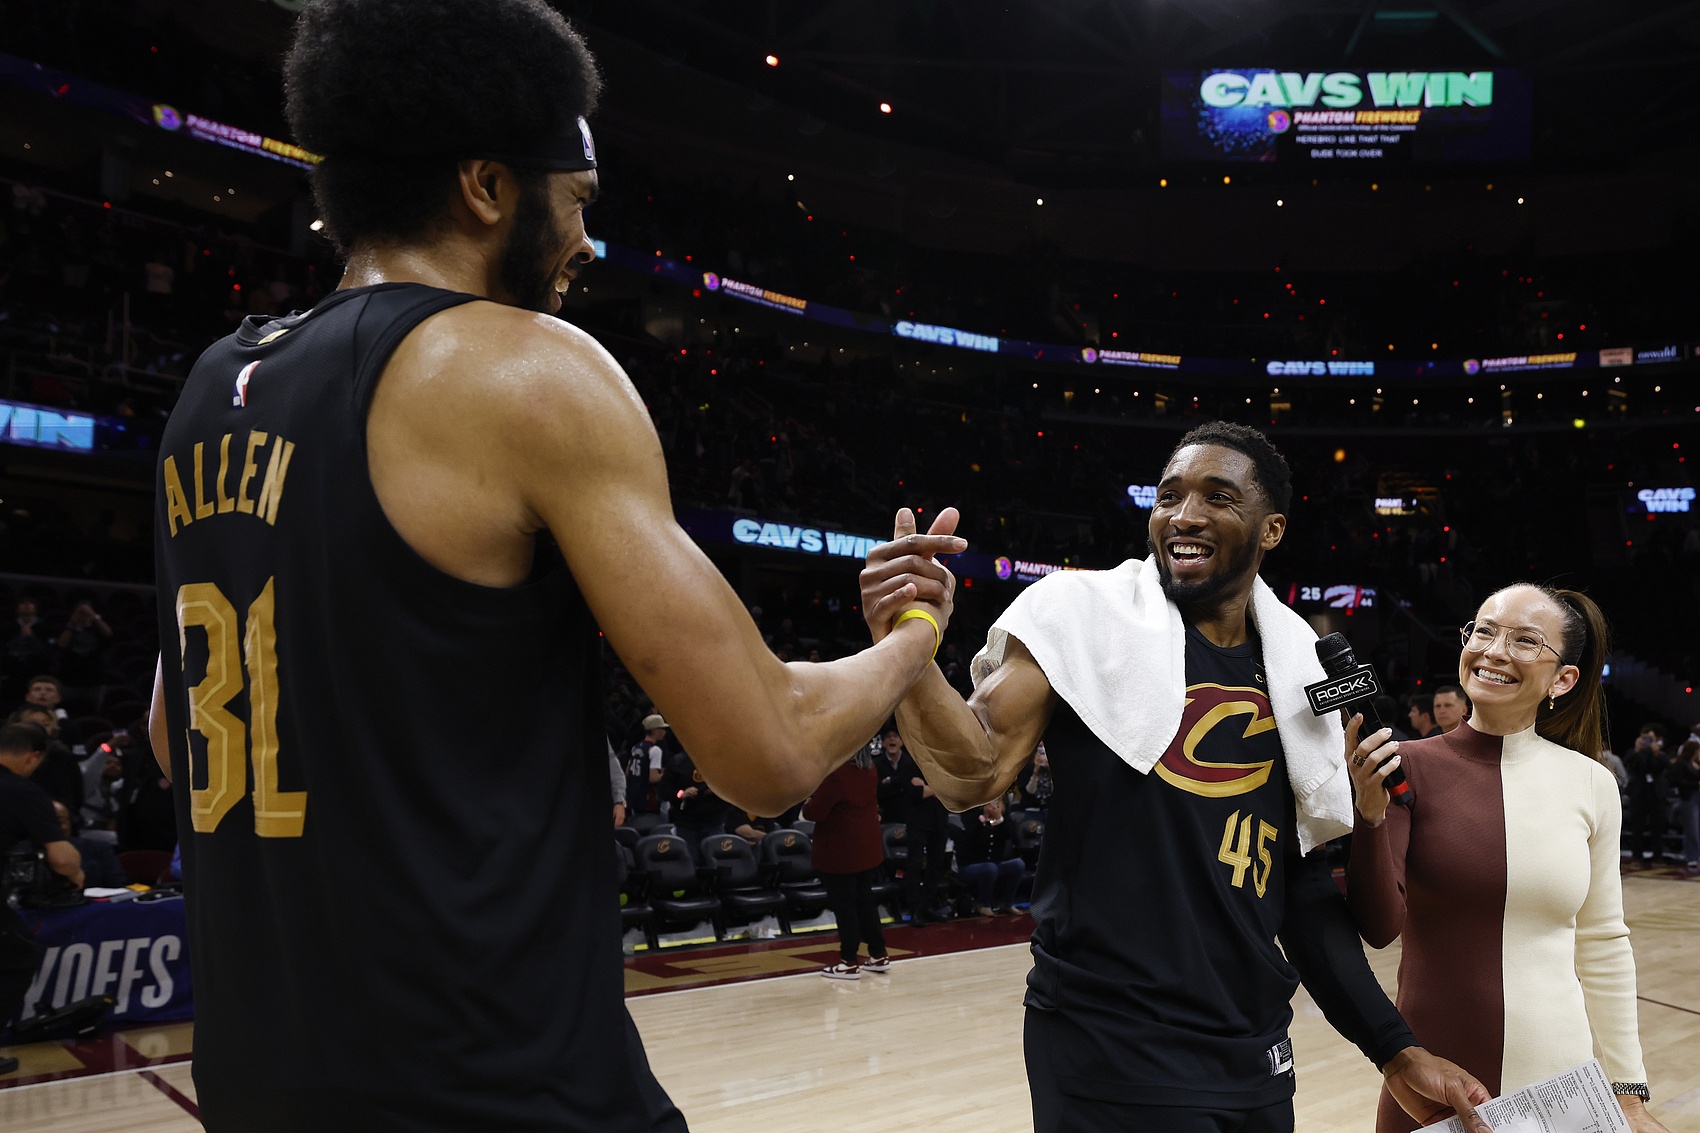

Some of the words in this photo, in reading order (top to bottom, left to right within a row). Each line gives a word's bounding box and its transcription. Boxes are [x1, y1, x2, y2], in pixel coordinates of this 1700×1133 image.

[1200, 71, 1363, 109] CAVS
[1367, 70, 1494, 108] WIN
[1293, 111, 1356, 125] PHANTOM
[1355, 109, 1421, 124] FIREWORKS
[1358, 134, 1379, 144] THAT
[1379, 134, 1401, 144] THAT
[721, 277, 765, 298] PHANTOM
[763, 289, 808, 310] FIREWORKS
[894, 319, 956, 345] CAVS
[955, 328, 1000, 353] WIN
[1098, 349, 1140, 361] PHANTOM
[1139, 352, 1182, 365] FIREWORKS
[1265, 360, 1328, 376] CAVS
[1327, 360, 1375, 376] WIN
[1481, 356, 1528, 369] PHANTOM
[1527, 351, 1578, 365] FIREWORKS
[0, 404, 94, 449] IN
[164, 429, 296, 538] ALLEN
[1127, 484, 1158, 498] CAV
[1637, 486, 1697, 501] CAVS
[1645, 499, 1691, 513] WIN
[732, 518, 825, 553] CAVS
[1300, 586, 1321, 601] 25
[1316, 676, 1368, 702] ROCK
[176, 575, 309, 838] 31
[1218, 809, 1278, 899] 45
[19, 934, 182, 1021] YOFFS
